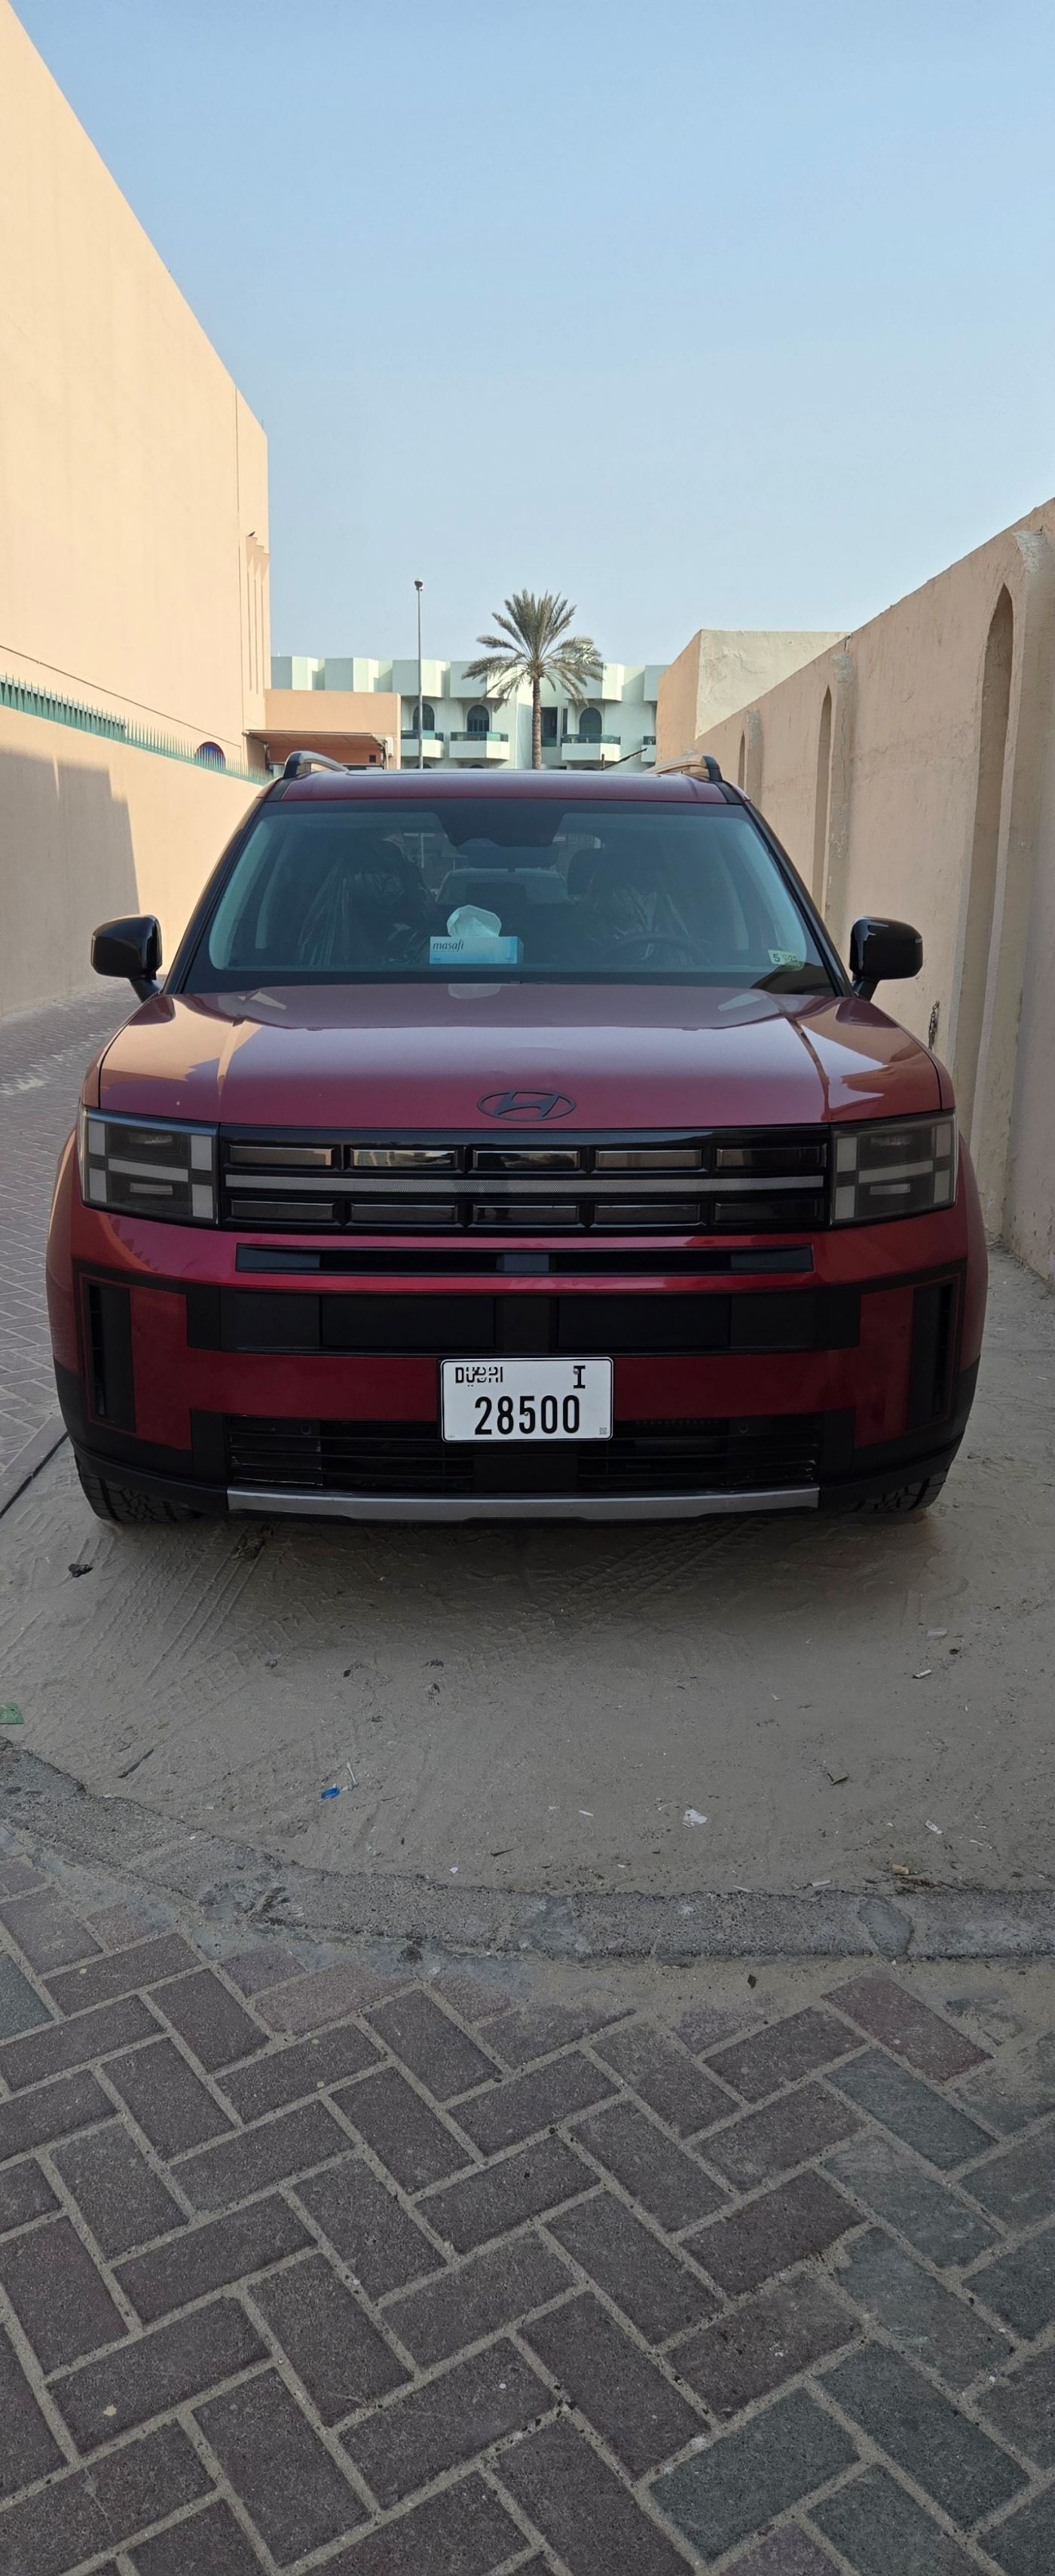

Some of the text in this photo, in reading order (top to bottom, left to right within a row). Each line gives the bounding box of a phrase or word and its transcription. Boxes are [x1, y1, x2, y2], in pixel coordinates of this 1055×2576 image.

[433, 939, 464, 952] masafi
[573, 1365, 586, 1389] I
[474, 1394, 579, 1435] 28500
